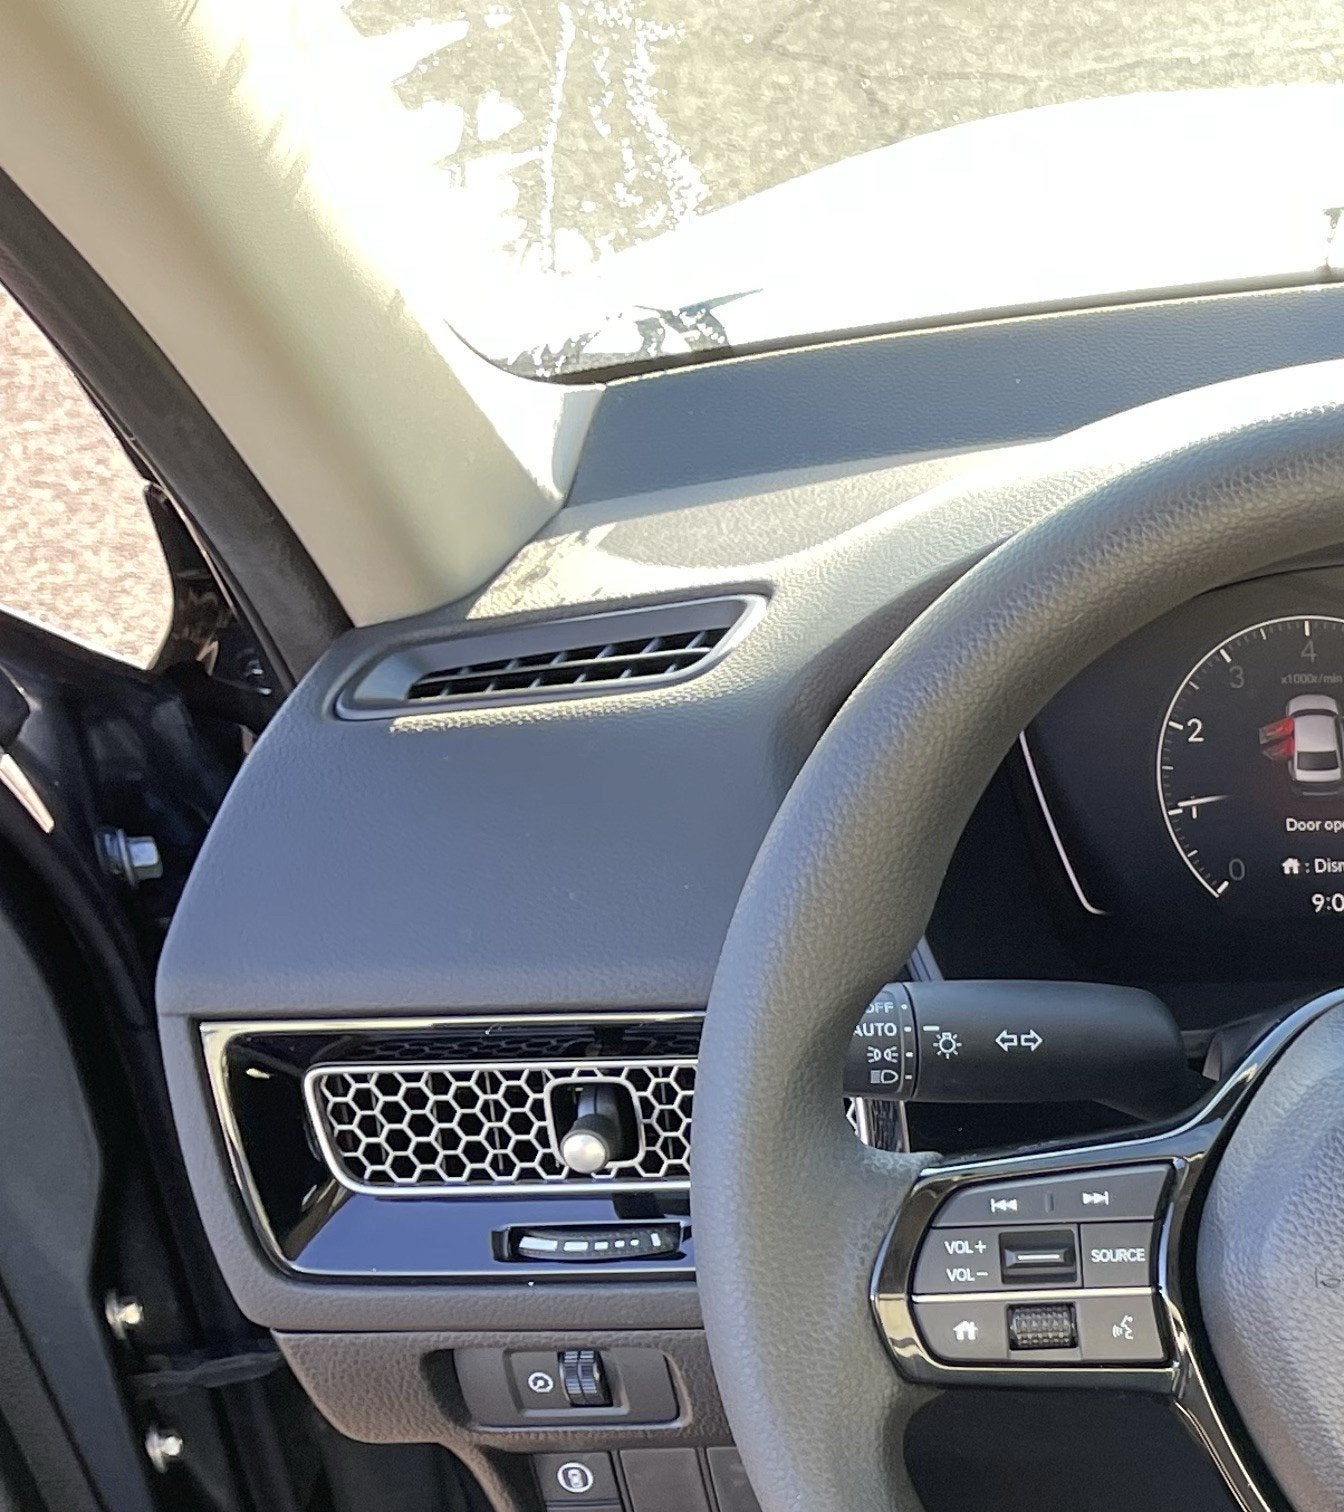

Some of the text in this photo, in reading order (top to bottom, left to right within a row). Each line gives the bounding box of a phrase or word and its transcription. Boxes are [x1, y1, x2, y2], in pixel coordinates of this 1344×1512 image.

[1300, 640, 1317, 662] 4
[1229, 665, 1245, 689] 3
[1187, 719, 1204, 742] 2
[1285, 817, 1322, 833] Door
[1228, 858, 1246, 881] 0
[853, 1022, 897, 1037] AUTO
[1090, 1248, 1146, 1263] SOURCE
